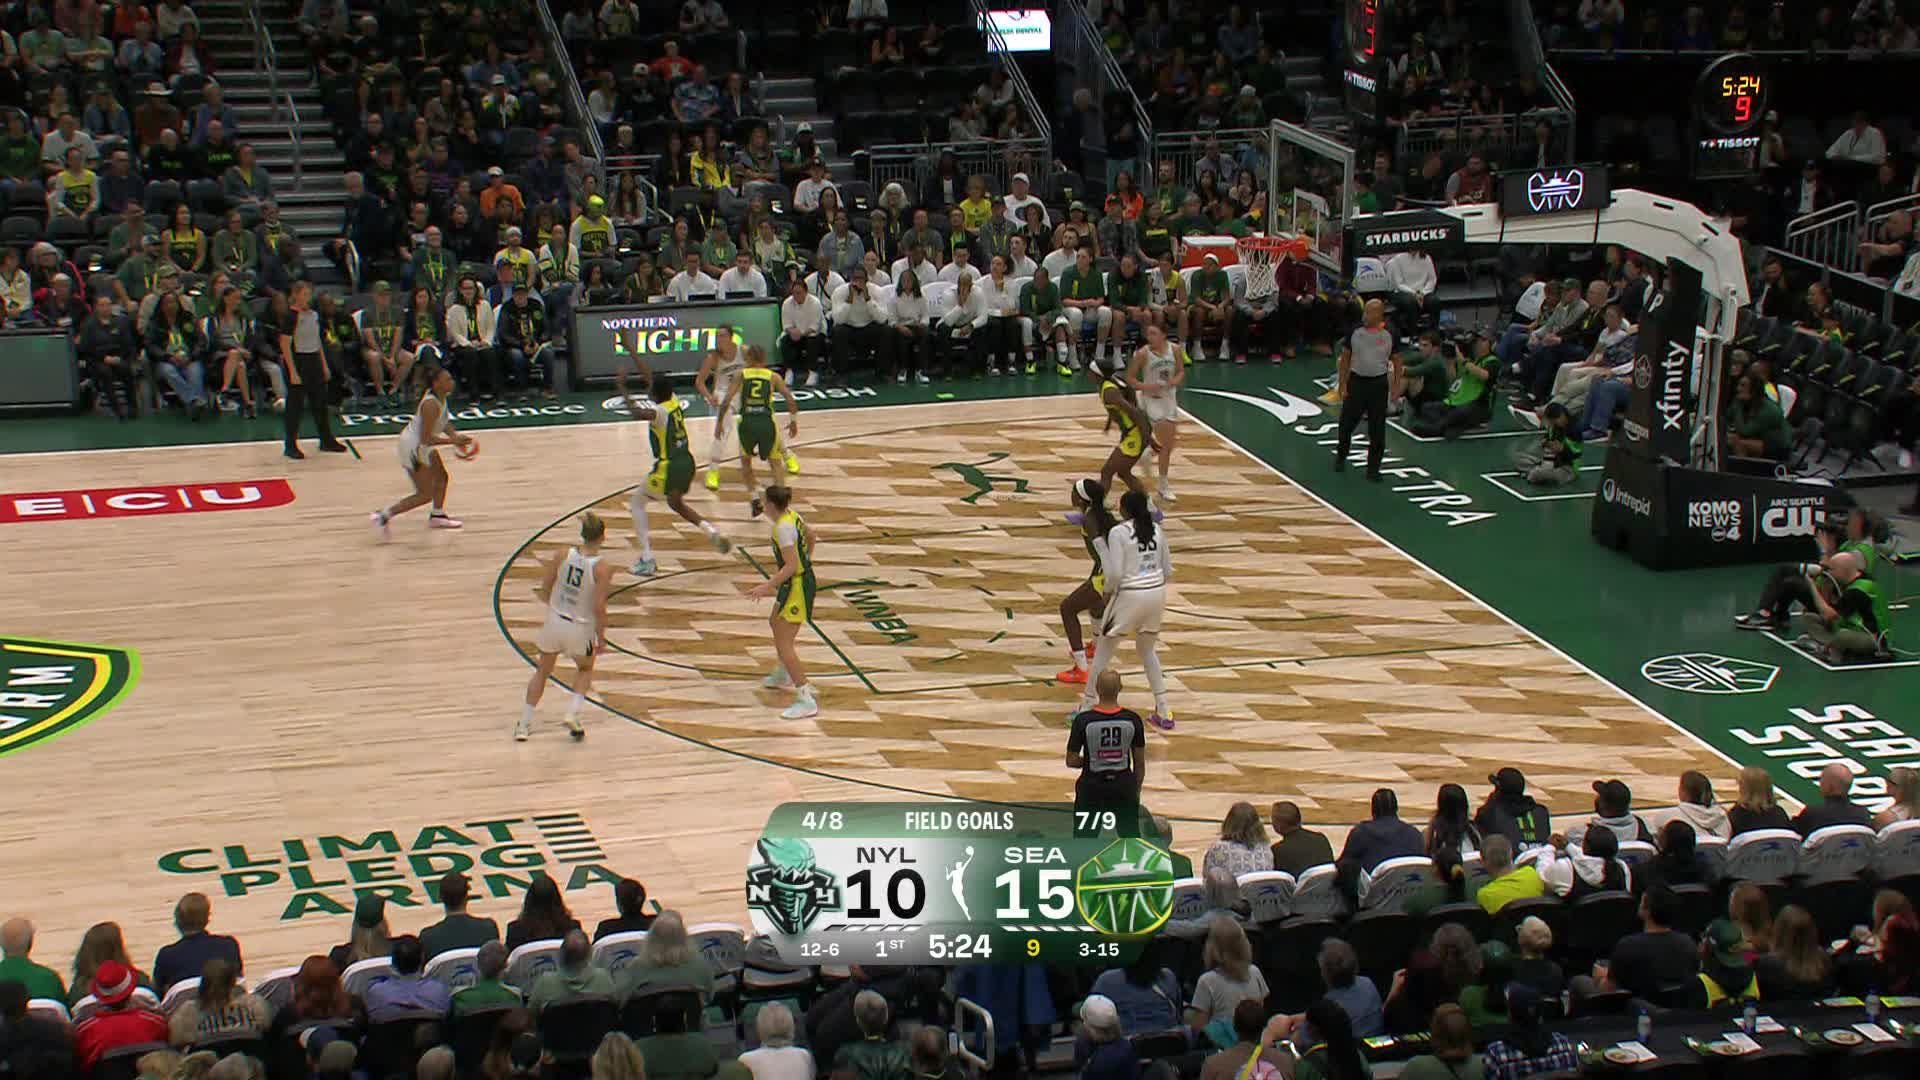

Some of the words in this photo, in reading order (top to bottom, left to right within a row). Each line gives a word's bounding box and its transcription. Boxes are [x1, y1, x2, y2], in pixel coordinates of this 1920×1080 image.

[1723, 76, 1760, 96] 5:24
[1735, 96, 1751, 121] 9
[1717, 137, 1760, 149] TISSOT
[1366, 228, 1447, 246] STARBUCKS
[601, 317, 677, 329] NORTHERN
[752, 380, 762, 397] 2
[1655, 340, 1690, 431] xfinity
[341, 403, 586, 426] Prodence
[1616, 488, 1651, 516] Intrepid
[1688, 500, 1741, 515] KOMO
[1688, 514, 1741, 528] NEWS
[1726, 527, 1741, 540] 4
[567, 564, 584, 587] 13
[842, 589, 919, 644] WNBA
[1101, 727, 1121, 747] 29
